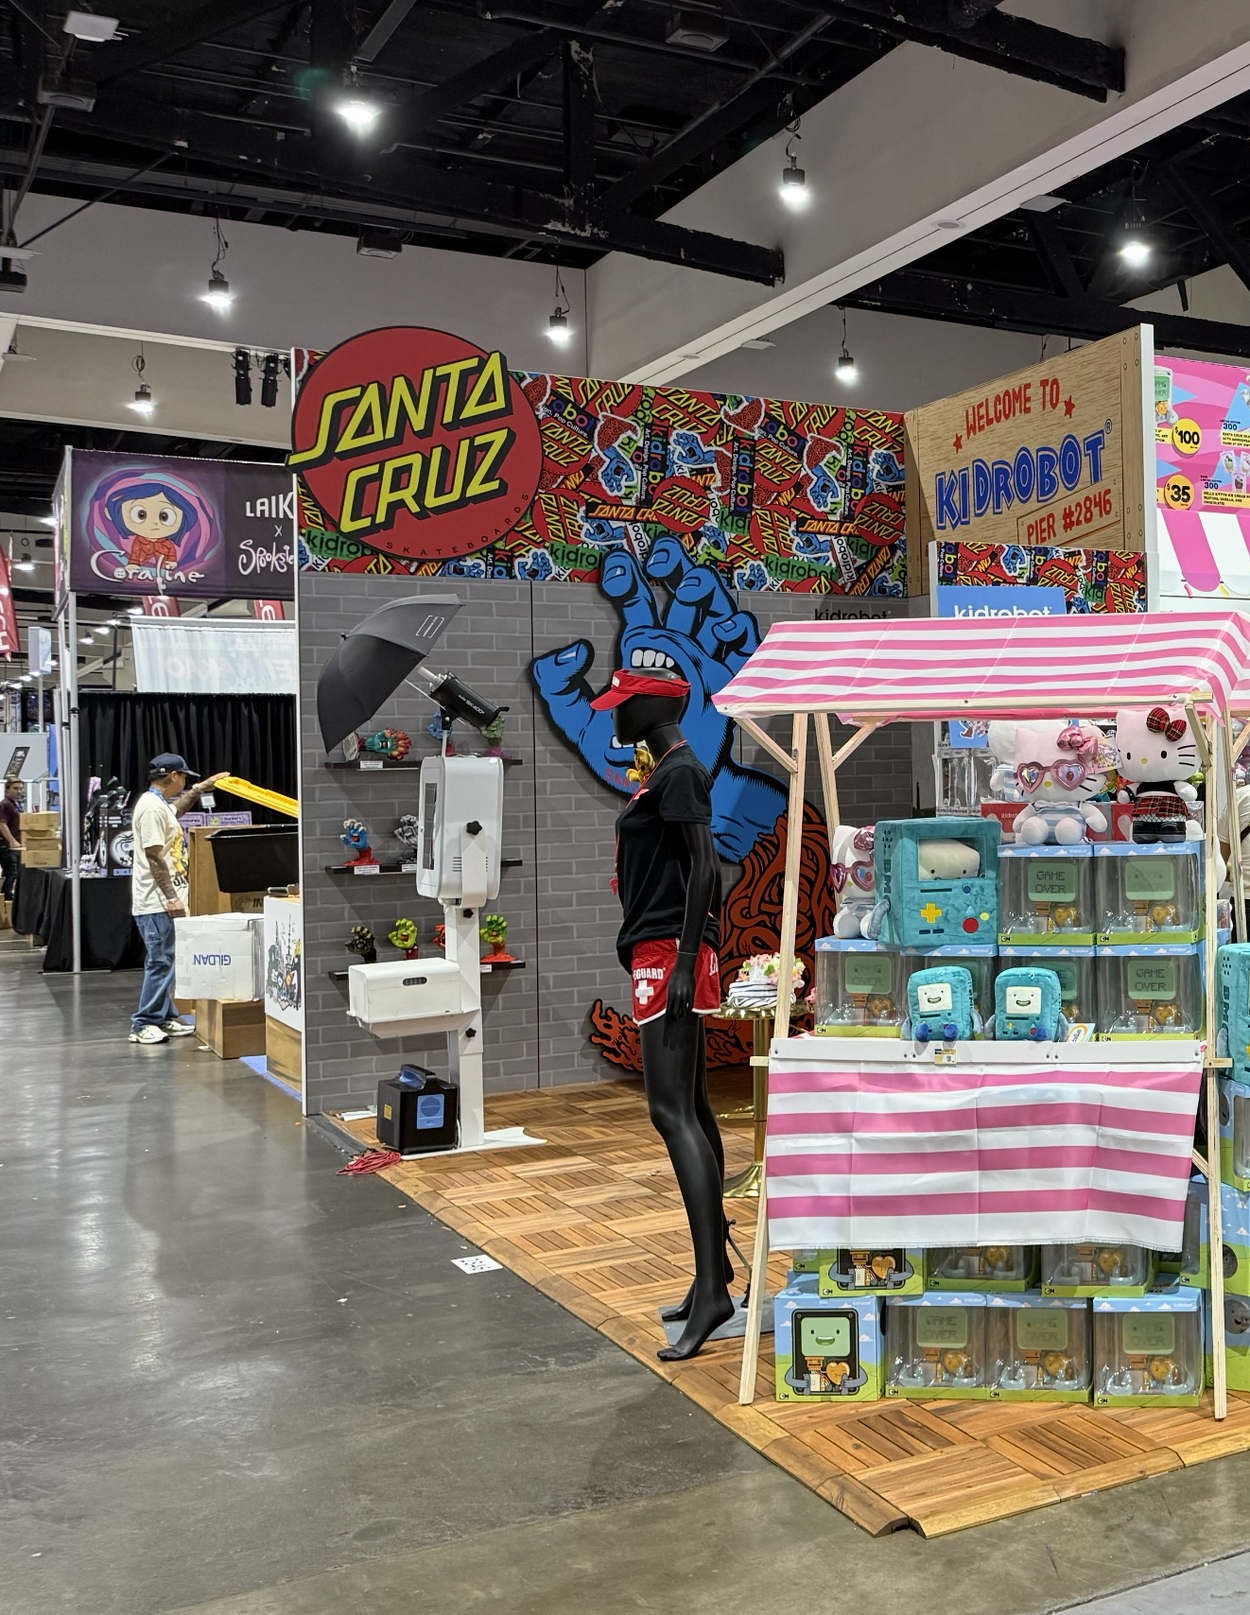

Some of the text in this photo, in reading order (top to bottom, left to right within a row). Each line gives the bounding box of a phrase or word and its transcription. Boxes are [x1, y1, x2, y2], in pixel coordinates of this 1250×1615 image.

[286, 350, 508, 467] SANTA
[549, 394, 596, 430] robot
[964, 377, 1061, 440] WELCOME TO
[763, 416, 804, 450] robot
[857, 408, 905, 443] SANT
[1174, 425, 1200, 446] $100
[1222, 422, 1238, 431] 300
[339, 427, 511, 534] CRUZ
[1167, 483, 1191, 503] $35
[1204, 481, 1219, 490] 300
[245, 491, 294, 519] LAIK
[1026, 488, 1113, 545] PIER #2846
[386, 493, 529, 555] SKATEBOARDS
[238, 540, 294, 575] Spooksie
[304, 529, 372, 558] kidro
[549, 544, 602, 566] kidro
[90, 549, 205, 596] Coraline
[1034, 884, 1067, 894] OVER
[1035, 870, 1067, 882] GAME
[193, 953, 232, 967] GILDAN
[1135, 967, 1167, 979] GAME
[1134, 981, 1167, 992] OVER
